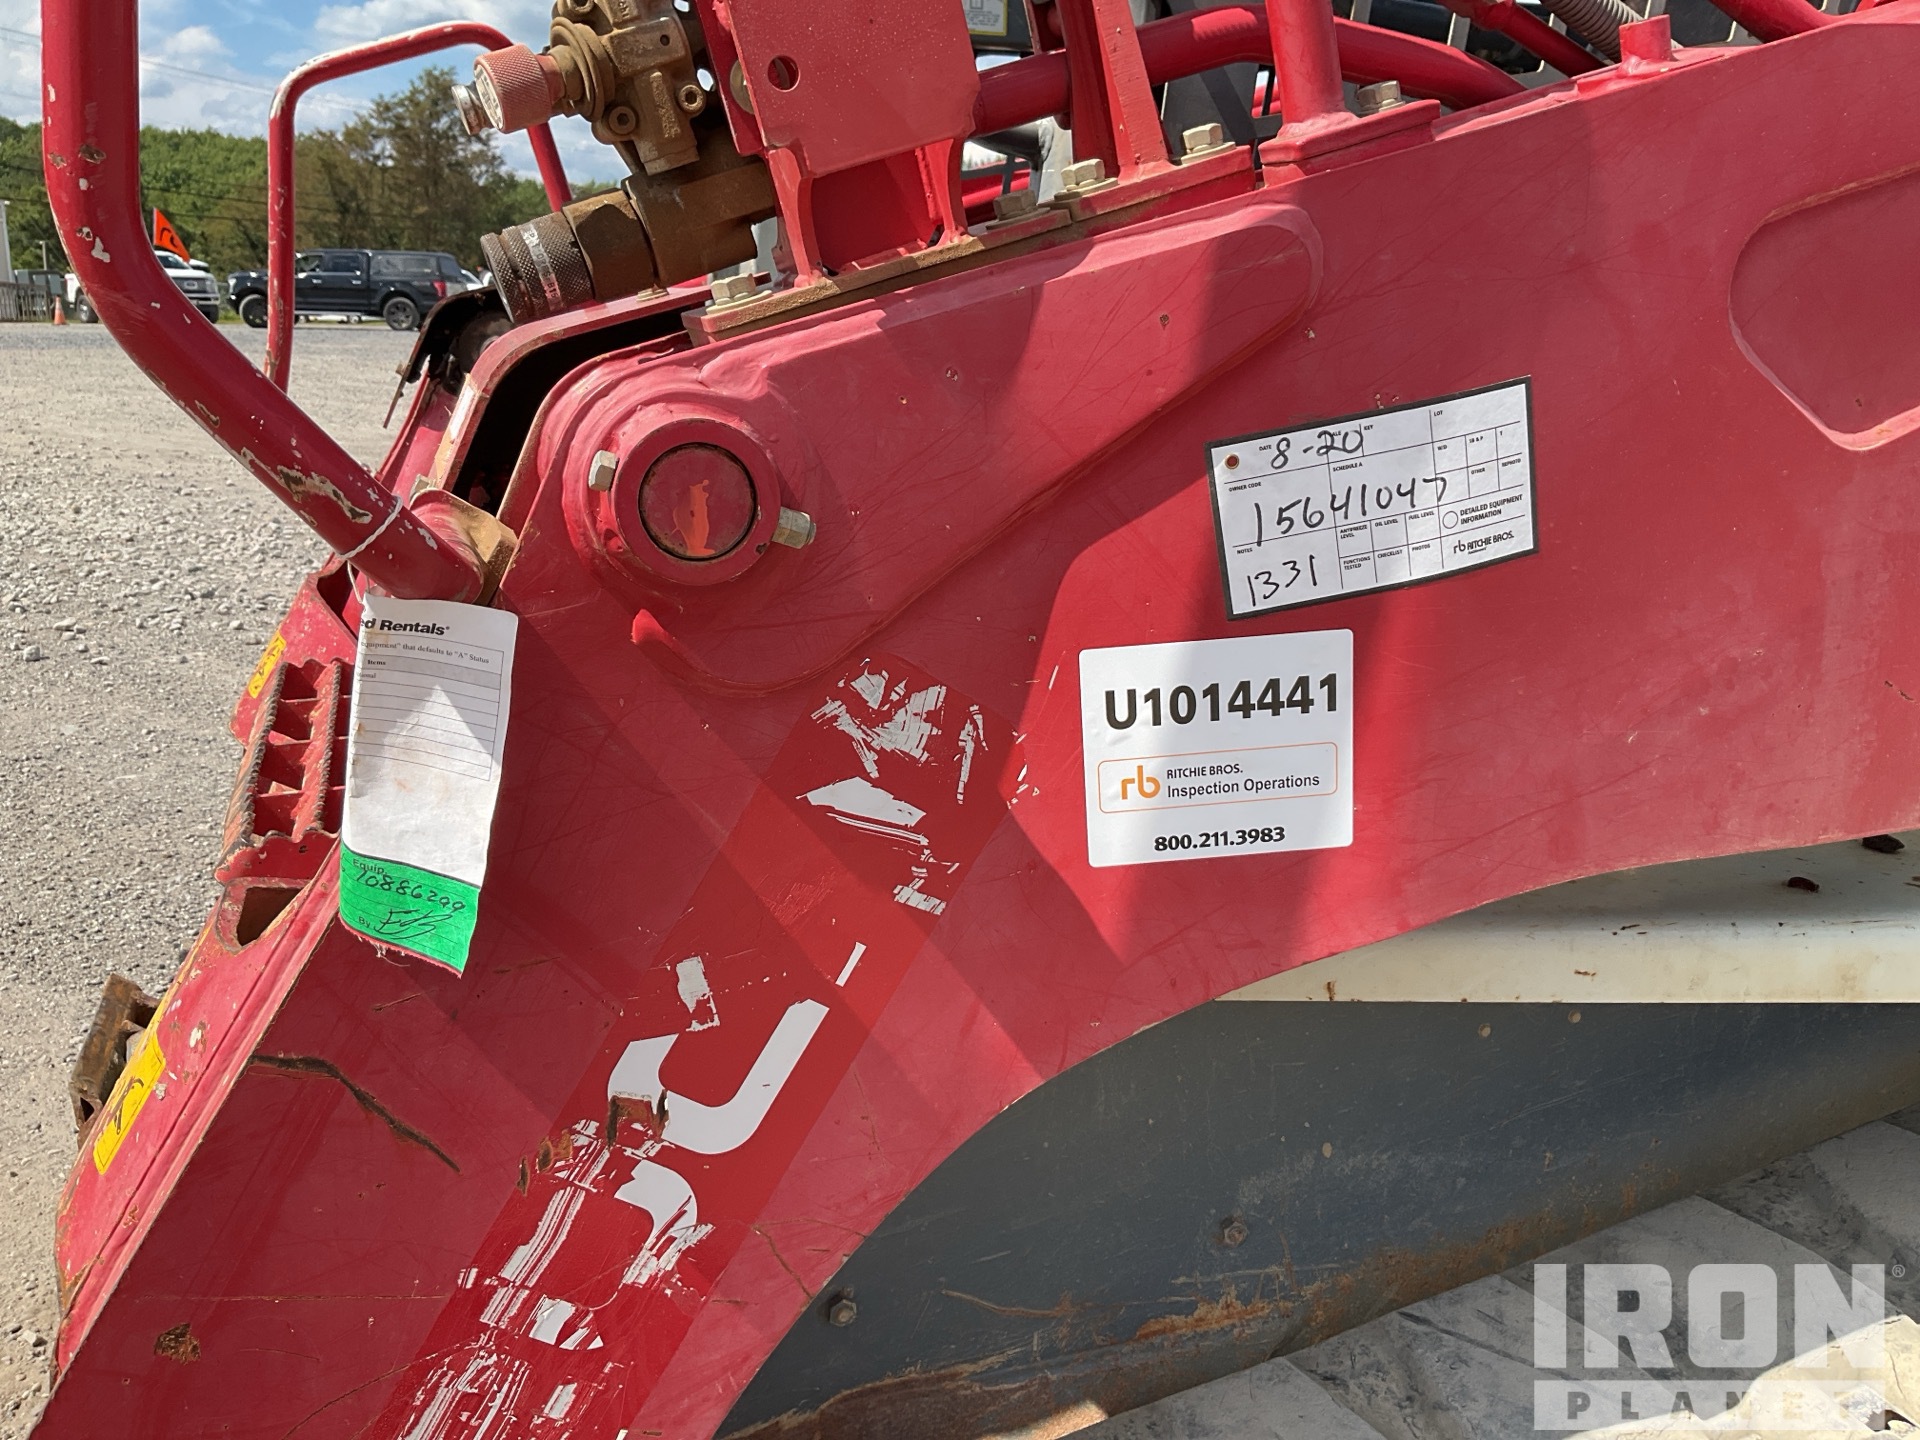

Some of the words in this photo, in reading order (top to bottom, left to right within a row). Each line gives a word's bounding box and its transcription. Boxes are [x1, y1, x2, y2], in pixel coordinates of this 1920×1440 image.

[1270, 430, 1364, 470] 8-20
[1333, 463, 1358, 472] SCHEDULE
[1471, 467, 1486, 475] OTHER
[1228, 484, 1247, 492] OWNER
[1254, 476, 1447, 547] 15641047
[1460, 503, 1488, 516] DETAILED
[1489, 494, 1523, 508] EQUIPMENT
[1460, 509, 1502, 525] INFORMATION
[1412, 543, 1430, 551] PHOTOS
[1453, 540, 1466, 554] rb
[1467, 536, 1492, 550] RITCHIE
[1493, 531, 1514, 543] BROS.
[1343, 556, 1371, 565] FUNCTIONS
[1377, 550, 1403, 558] CHECKLIST
[1247, 554, 1318, 607] 1331
[402, 643, 416, 651] that
[417, 645, 444, 655] defaults
[469, 654, 490, 664] Status
[1104, 673, 1338, 730] U1014441
[1120, 765, 1161, 801] rb
[1166, 767, 1207, 779] RITCHIE
[1209, 763, 1243, 775] BROS.
[1167, 778, 1240, 799] Inspection
[1243, 773, 1320, 795] Operations
[1154, 826, 1286, 851] 800.211.3983
[358, 916, 371, 928] By
